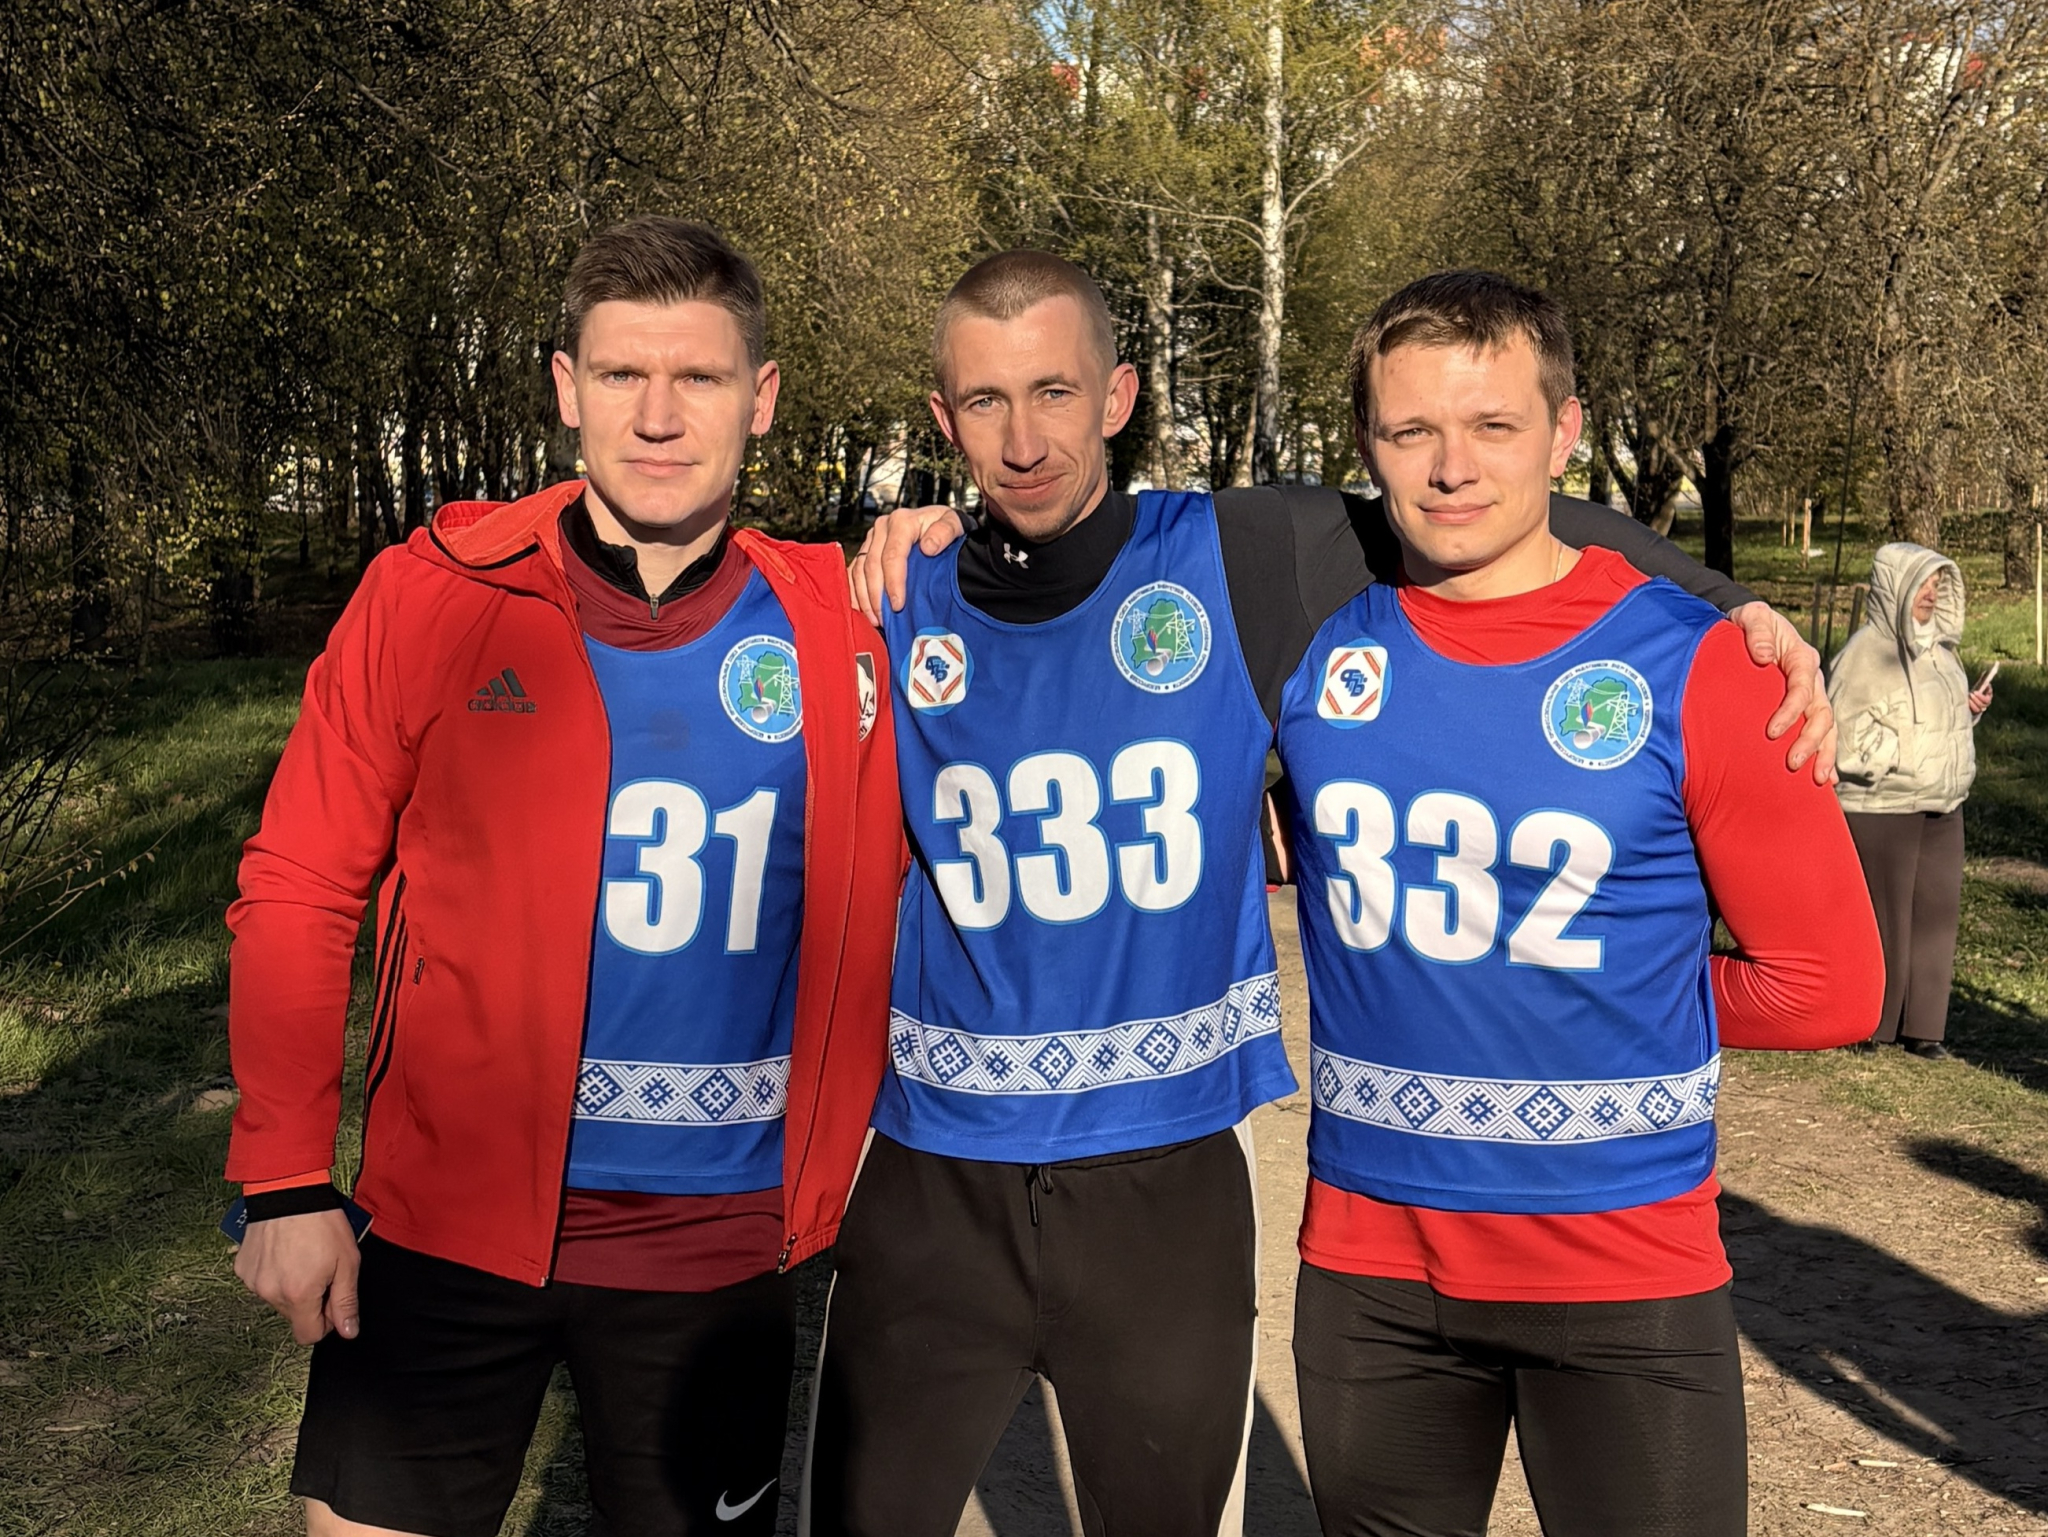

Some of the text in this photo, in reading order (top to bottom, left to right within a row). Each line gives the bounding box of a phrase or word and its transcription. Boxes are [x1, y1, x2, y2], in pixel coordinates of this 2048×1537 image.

[467, 695, 537, 714] adidas
[603, 778, 778, 955] 31
[933, 733, 1204, 932] 333
[1313, 778, 1616, 972] 332
